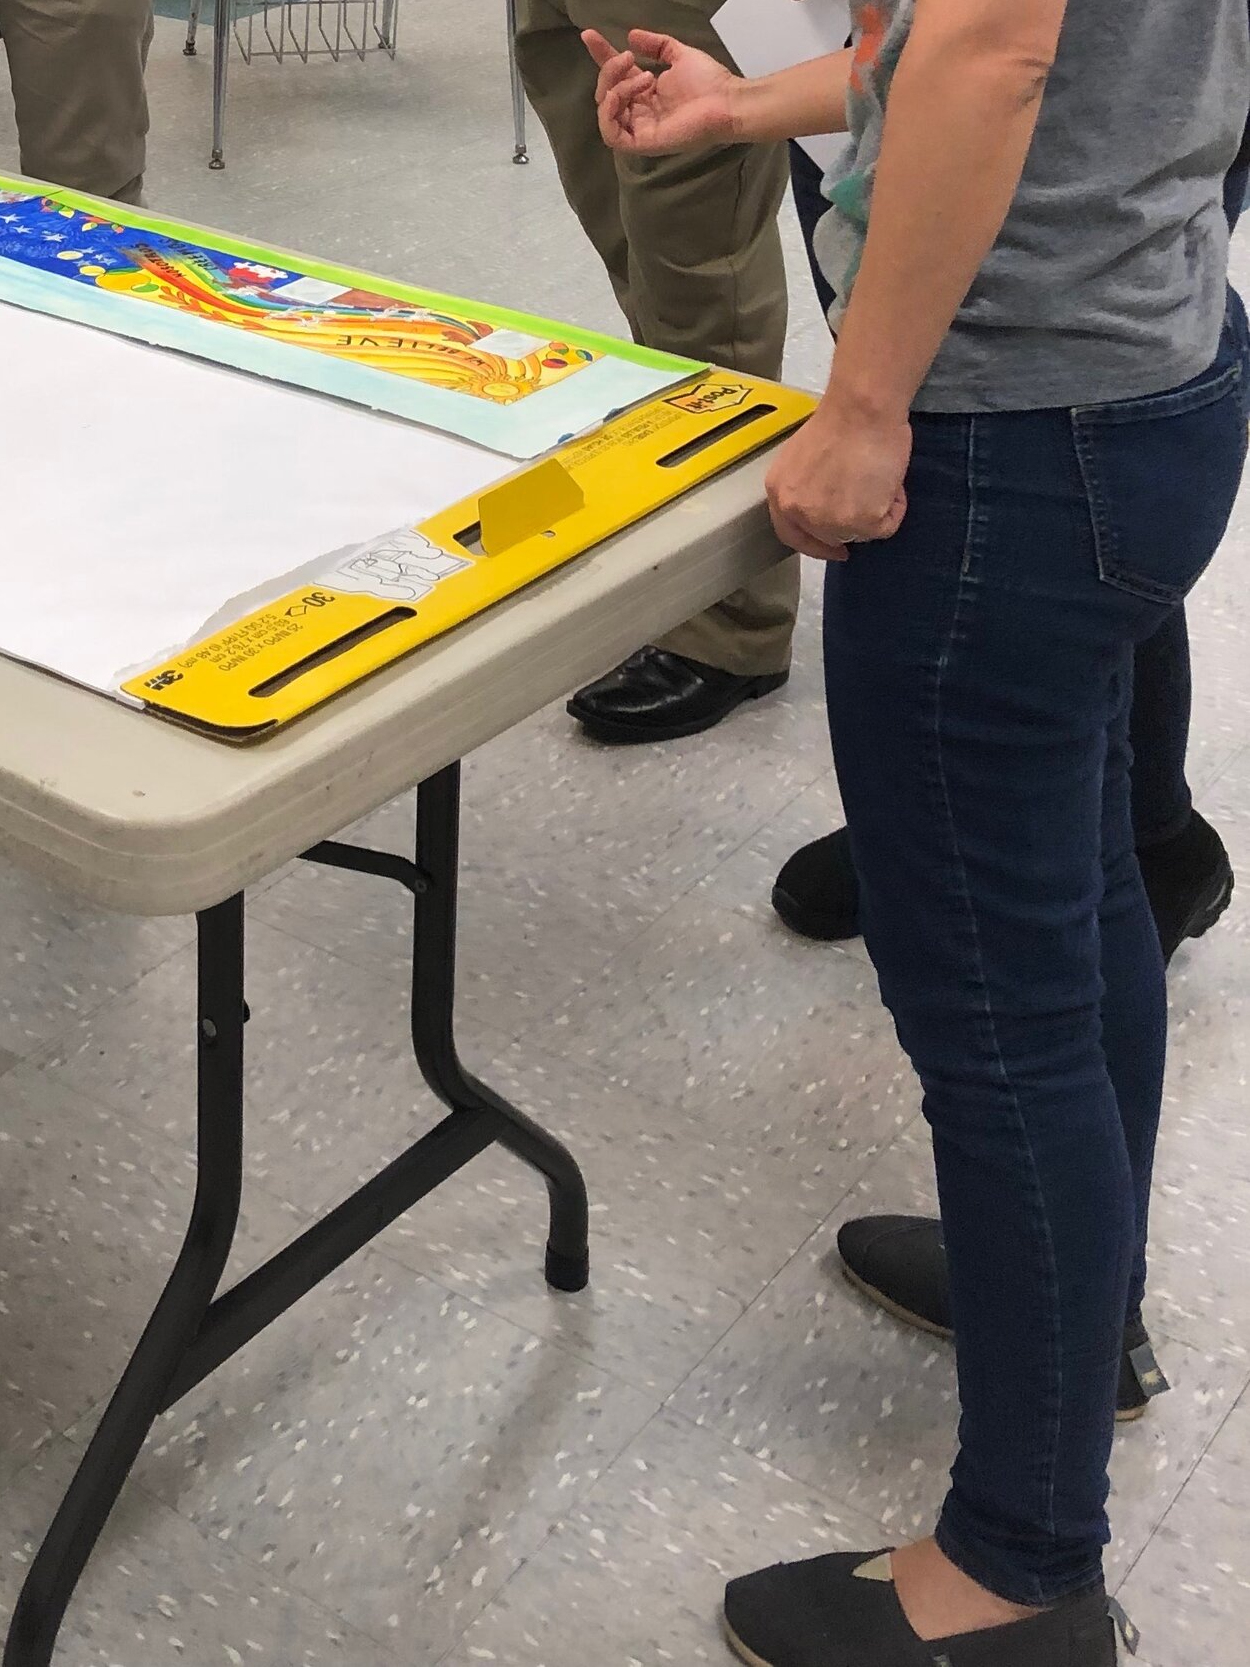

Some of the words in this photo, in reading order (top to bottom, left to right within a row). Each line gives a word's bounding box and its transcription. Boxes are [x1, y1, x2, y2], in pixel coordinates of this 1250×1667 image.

[336, 335, 460, 354] BELIEVE
[301, 591, 335, 607] 30
[252, 629, 268, 638] cm
[209, 653, 227, 663] cm
[144, 670, 183, 691] 3M
